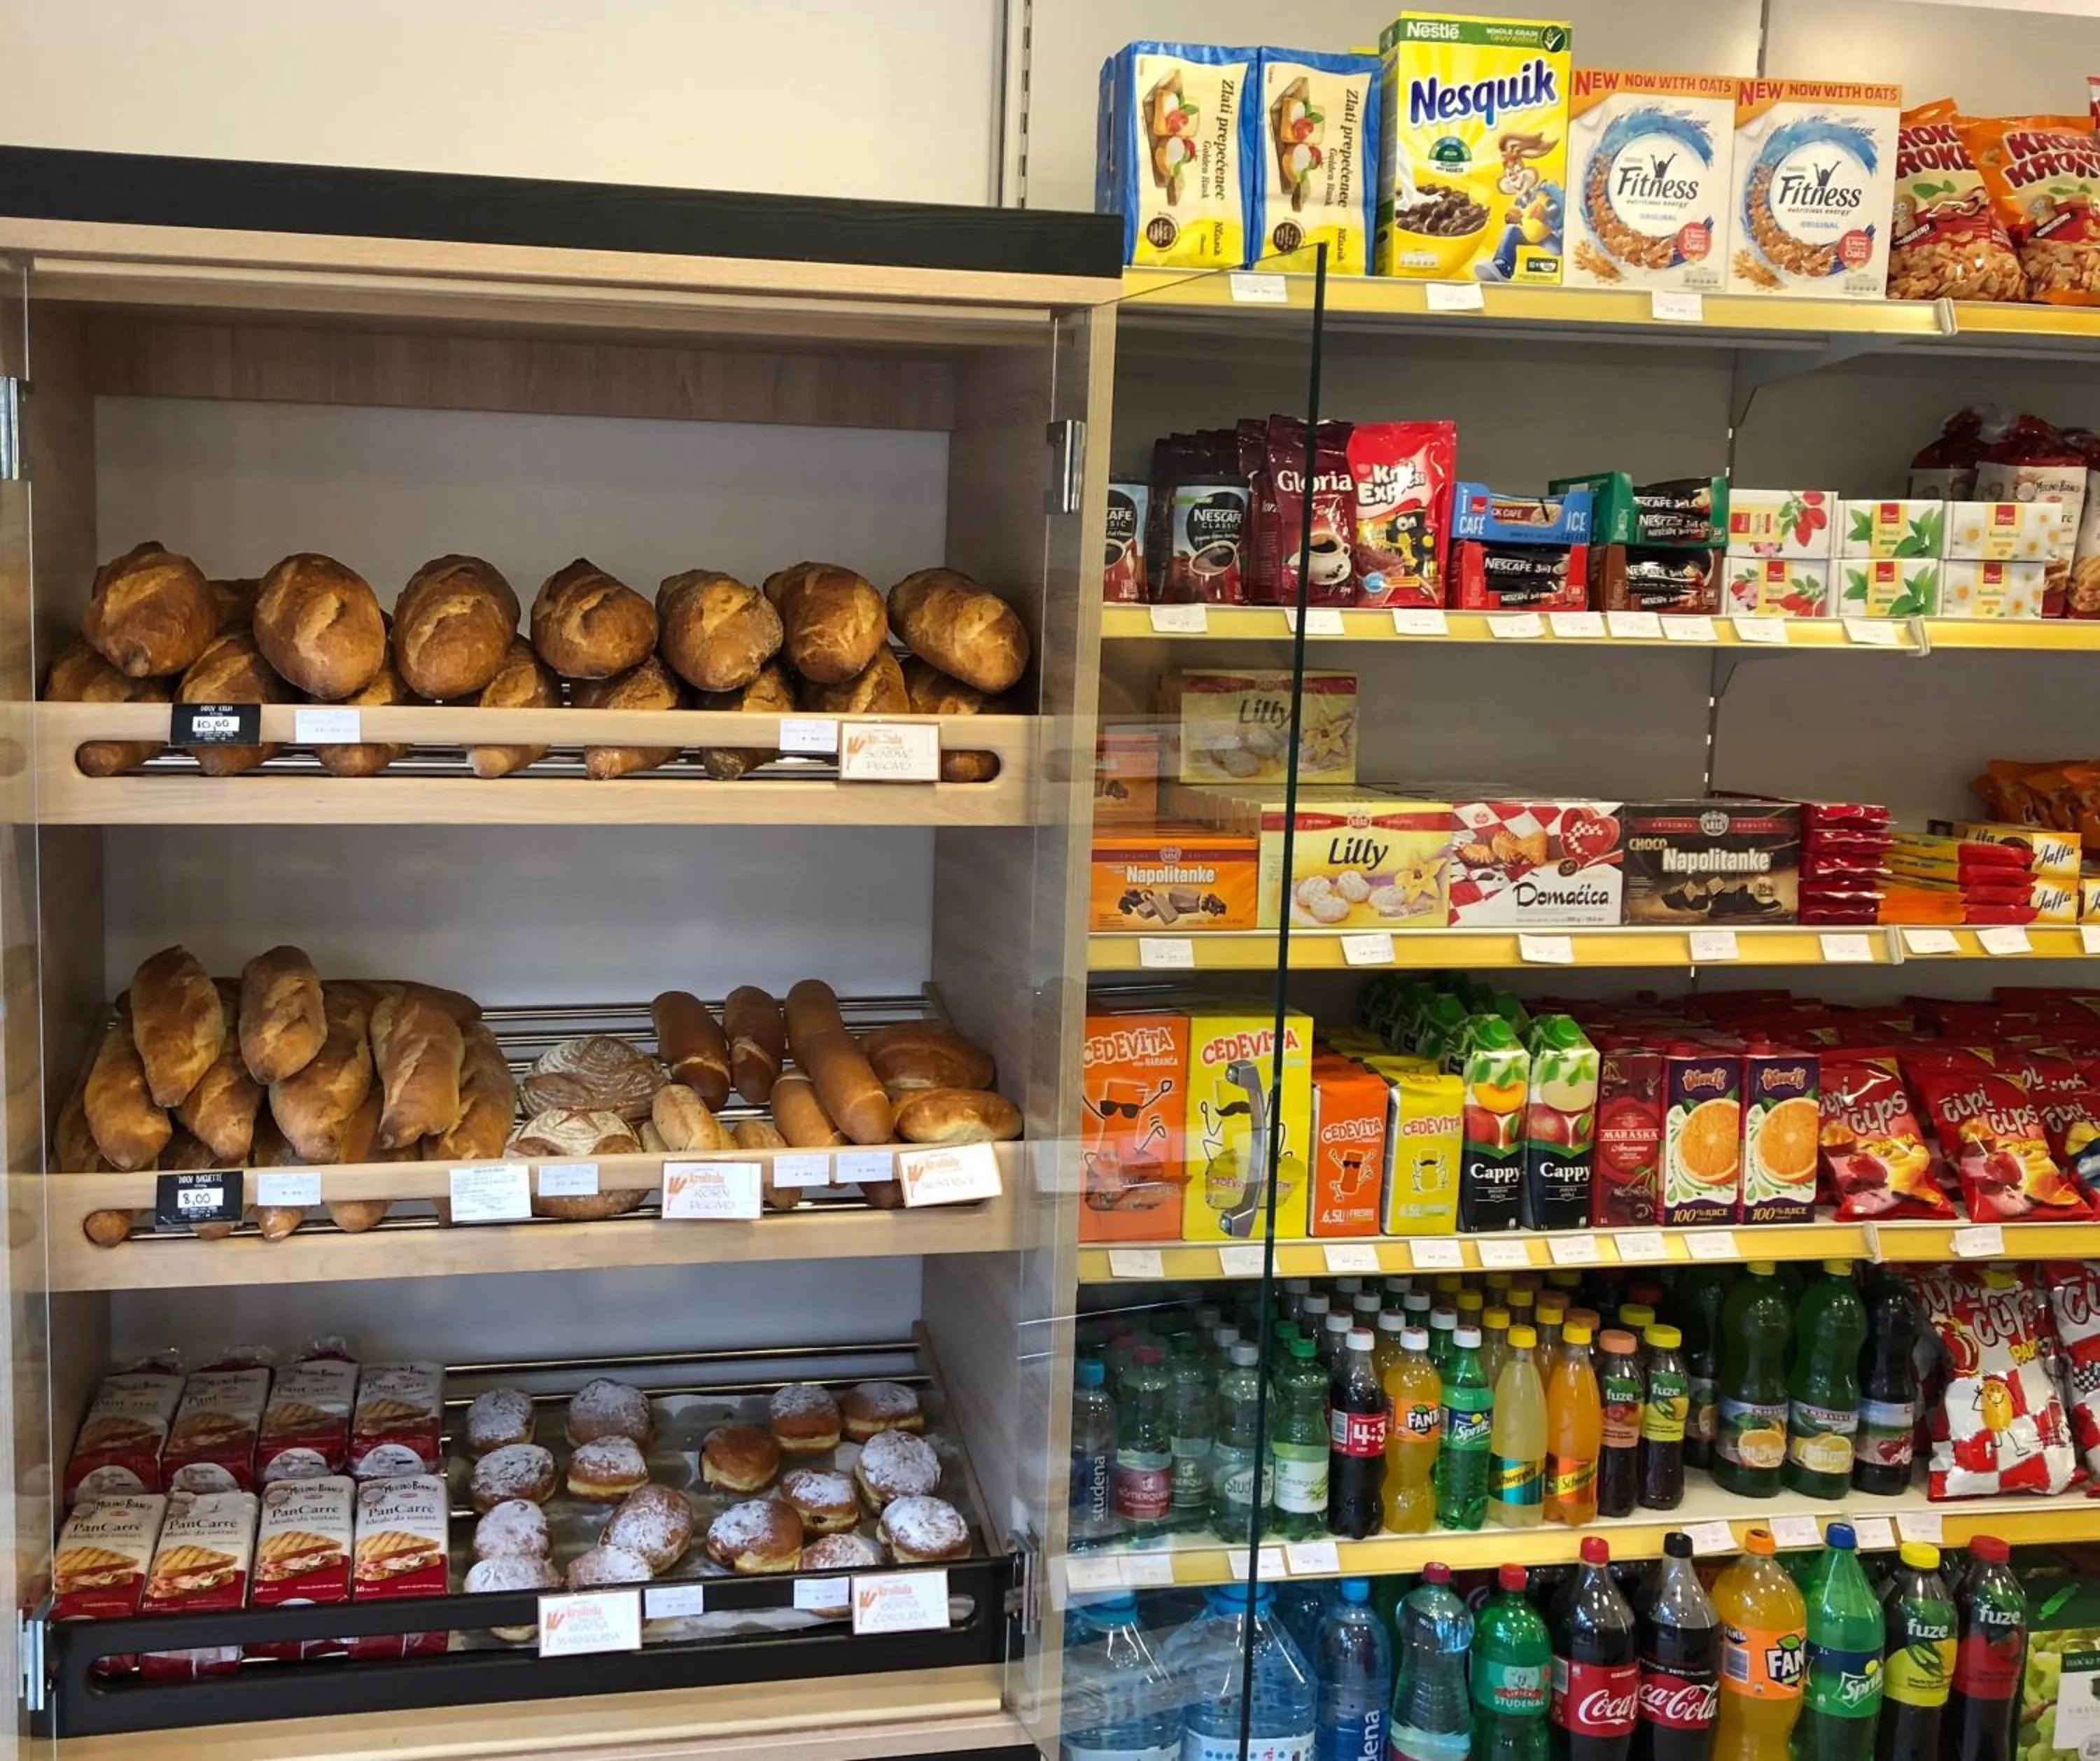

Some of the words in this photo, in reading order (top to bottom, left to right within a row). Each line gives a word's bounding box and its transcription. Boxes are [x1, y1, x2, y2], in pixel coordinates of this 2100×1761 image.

[1406, 21, 1460, 39] Nestlé
[1410, 59, 1557, 126] Nesquik
[1575, 71, 1619, 96] NEW
[1625, 74, 1659, 88] NOW
[1659, 76, 1695, 90] WITH
[1700, 78, 1732, 93] OATS
[1738, 81, 1784, 106] NEW
[1789, 83, 1823, 97] NOW
[1823, 85, 1861, 99] WITH
[1865, 87, 1898, 101] OATS
[1222, 79, 1234, 114] Zlati
[1345, 89, 1359, 122] Zlati
[1617, 166, 1699, 199] Fitness
[1779, 175, 1862, 208] Fitness
[1566, 512, 1588, 532] ICE
[1239, 699, 1292, 729] Lilly
[1328, 837, 1389, 871] Lilly
[1628, 838, 1667, 850] CHOCO
[2037, 841, 2074, 865] Jaffa
[1662, 848, 1771, 874] Napolitanke
[1126, 864, 1216, 886] Napolitanke
[1513, 882, 1609, 907] Domaćica
[2037, 889, 2072, 910] Jaffa
[1084, 1027, 1175, 1066] CEDEVITA
[1322, 1118, 1383, 1142] CEDEVITA
[1403, 1116, 1461, 1137] CEDEVITA
[1604, 1130, 1658, 1141] MARASKA
[1470, 1163, 1520, 1181] Cappy
[1540, 1162, 1590, 1181] Cappy
[182, 1192, 211, 1206] 8,00
[1606, 1388, 1633, 1401] fuze
[1651, 1382, 1681, 1396] fuze
[1408, 1412, 1440, 1427] FANT
[1093, 1455, 1106, 1522] studena
[1980, 1605, 2021, 1625] fuze
[1907, 1618, 1948, 1639] fuze
[1767, 1648, 1805, 1678] FAN
[1639, 1680, 1719, 1721] ca-Cola
